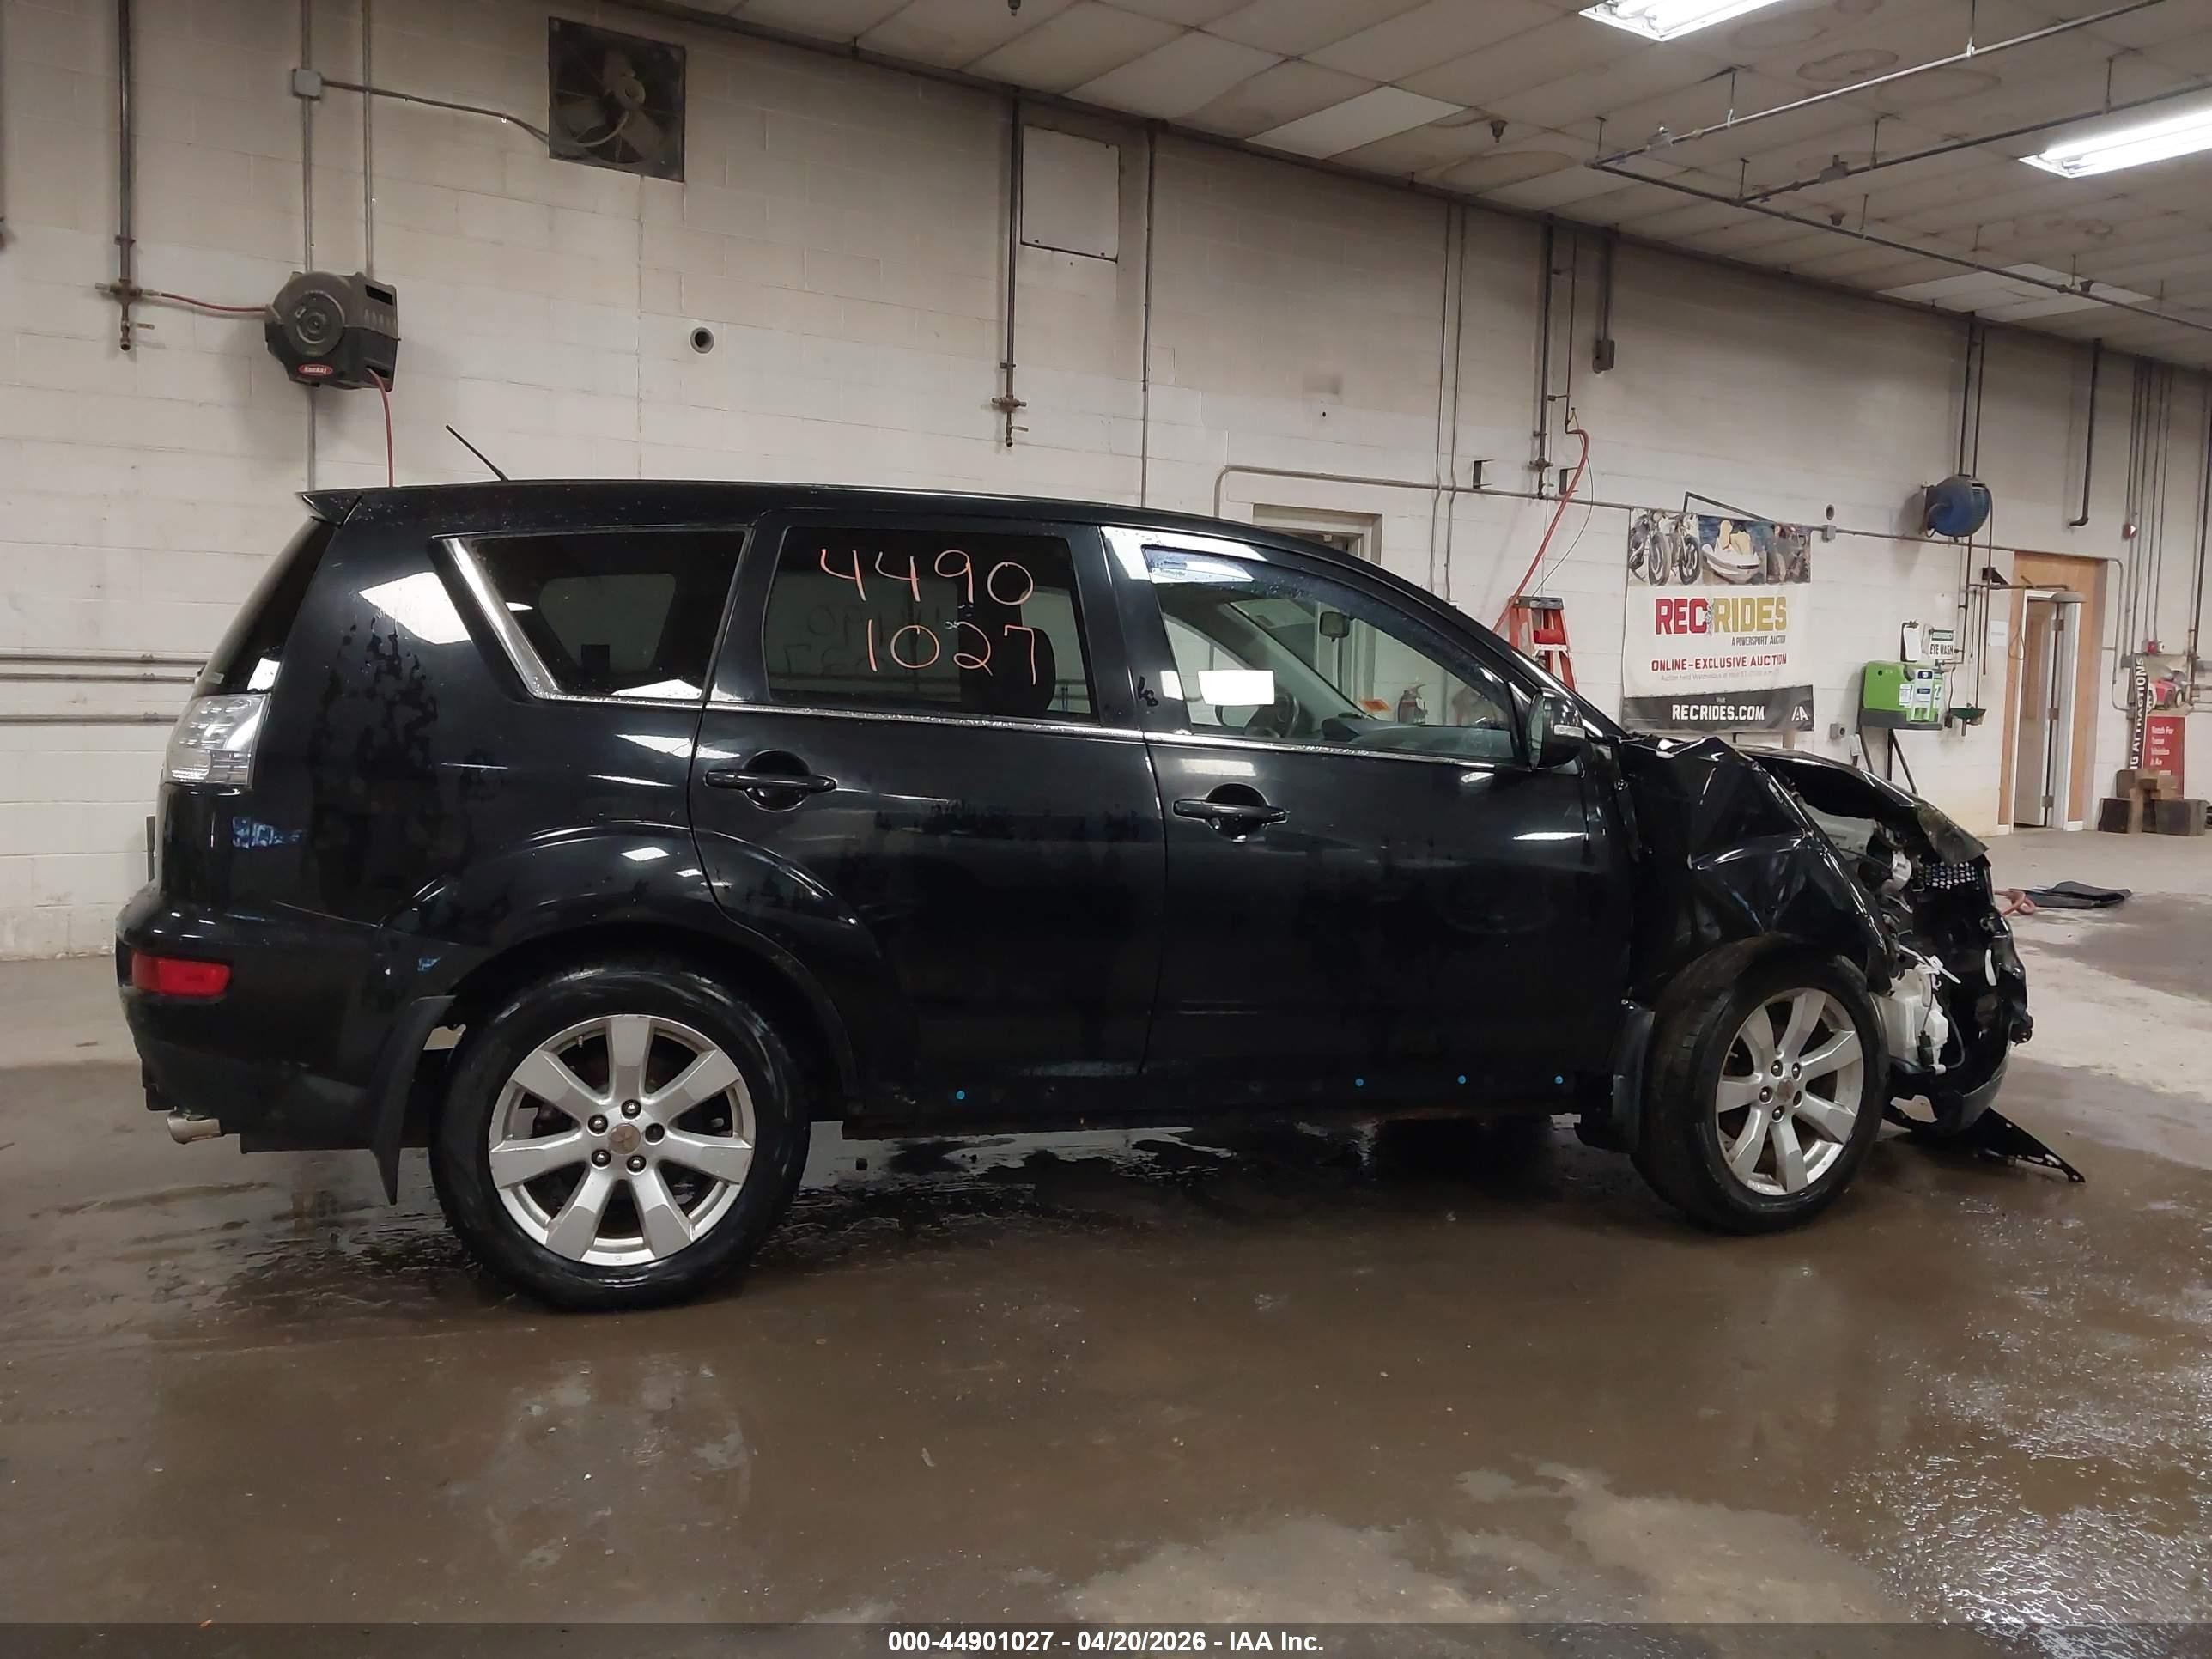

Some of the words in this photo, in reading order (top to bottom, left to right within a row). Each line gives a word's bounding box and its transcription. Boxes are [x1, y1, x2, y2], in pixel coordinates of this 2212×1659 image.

[820, 549, 1034, 605] 4490
[1655, 598, 1708, 635] REC
[1713, 596, 1787, 634] RIDES
[1736, 635, 1768, 647] POWERSPORT
[1929, 643, 1939, 655] EYE
[1940, 644, 1953, 655] WASH
[867, 618, 1037, 686] 1027
[1651, 657, 1747, 672] ONLINE-EXCLUSIVE
[1750, 653, 1787, 667] AUCTION
[1672, 704, 1765, 721] RECRIDES.COM
